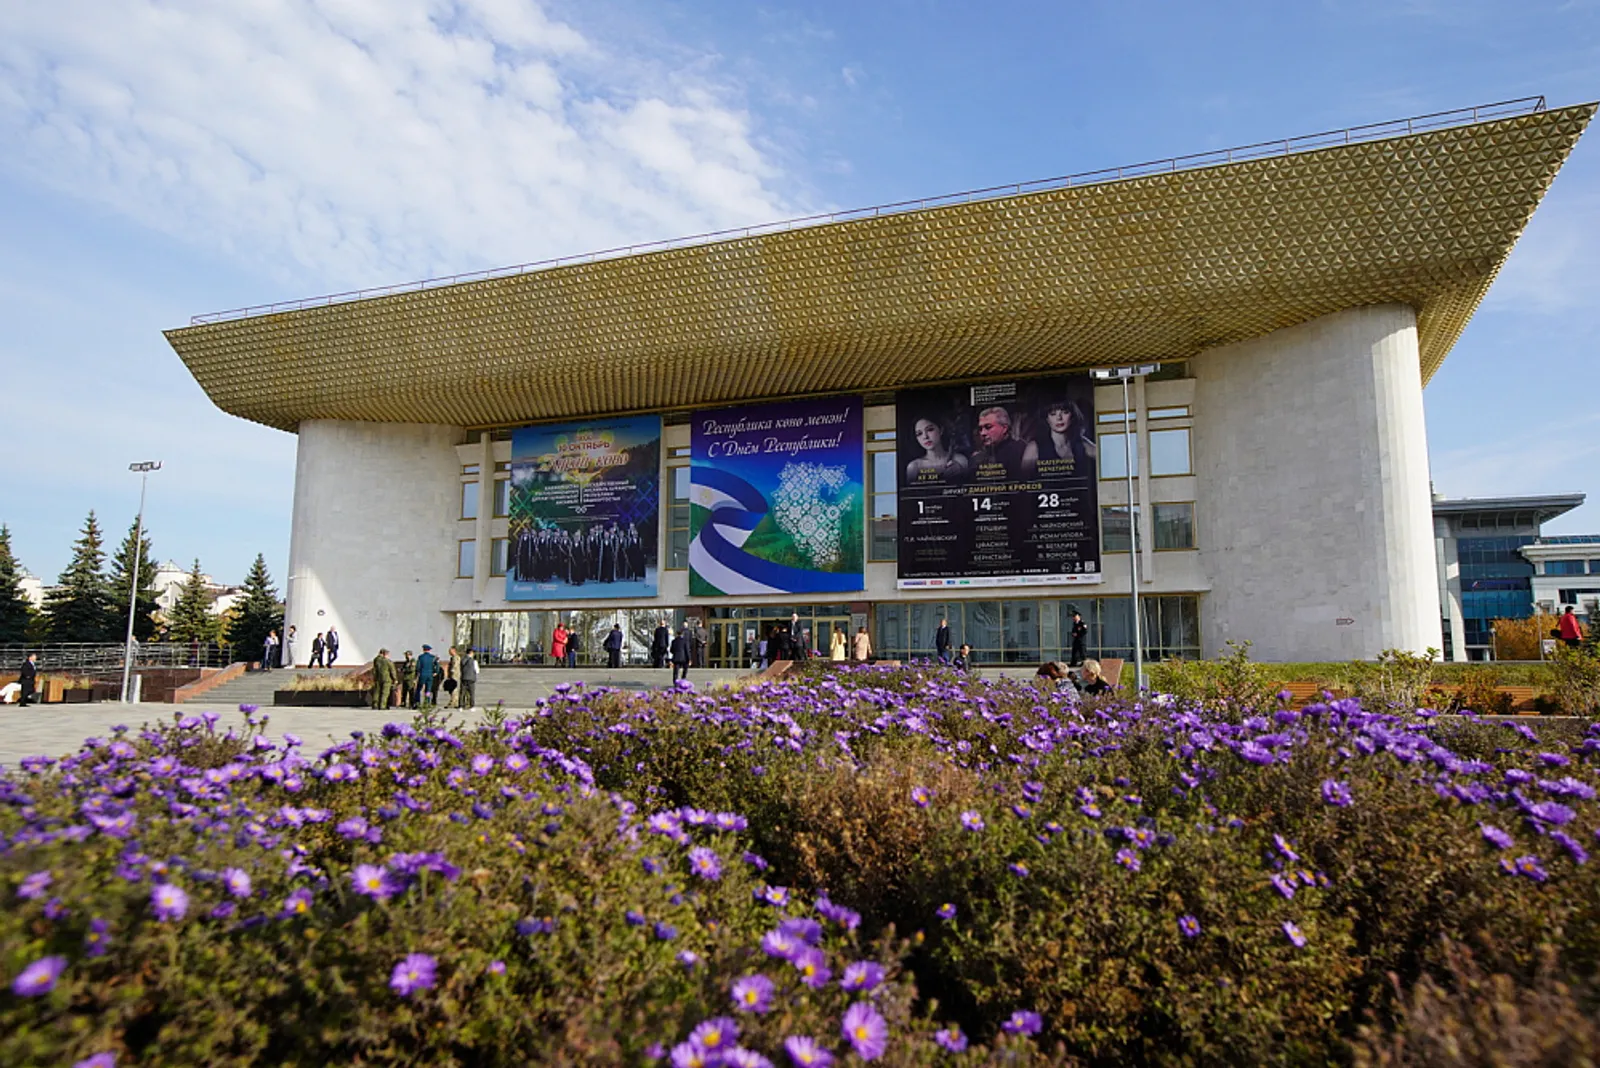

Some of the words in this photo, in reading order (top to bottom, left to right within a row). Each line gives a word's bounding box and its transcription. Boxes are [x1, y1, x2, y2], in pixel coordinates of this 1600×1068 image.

[703, 416, 773, 439] Республика
[707, 442, 720, 458] С
[722, 441, 760, 457] Днём
[763, 431, 844, 456] Республики!
[918, 501, 924, 513] 1
[972, 498, 992, 511] 14
[1037, 493, 1060, 507] 28
